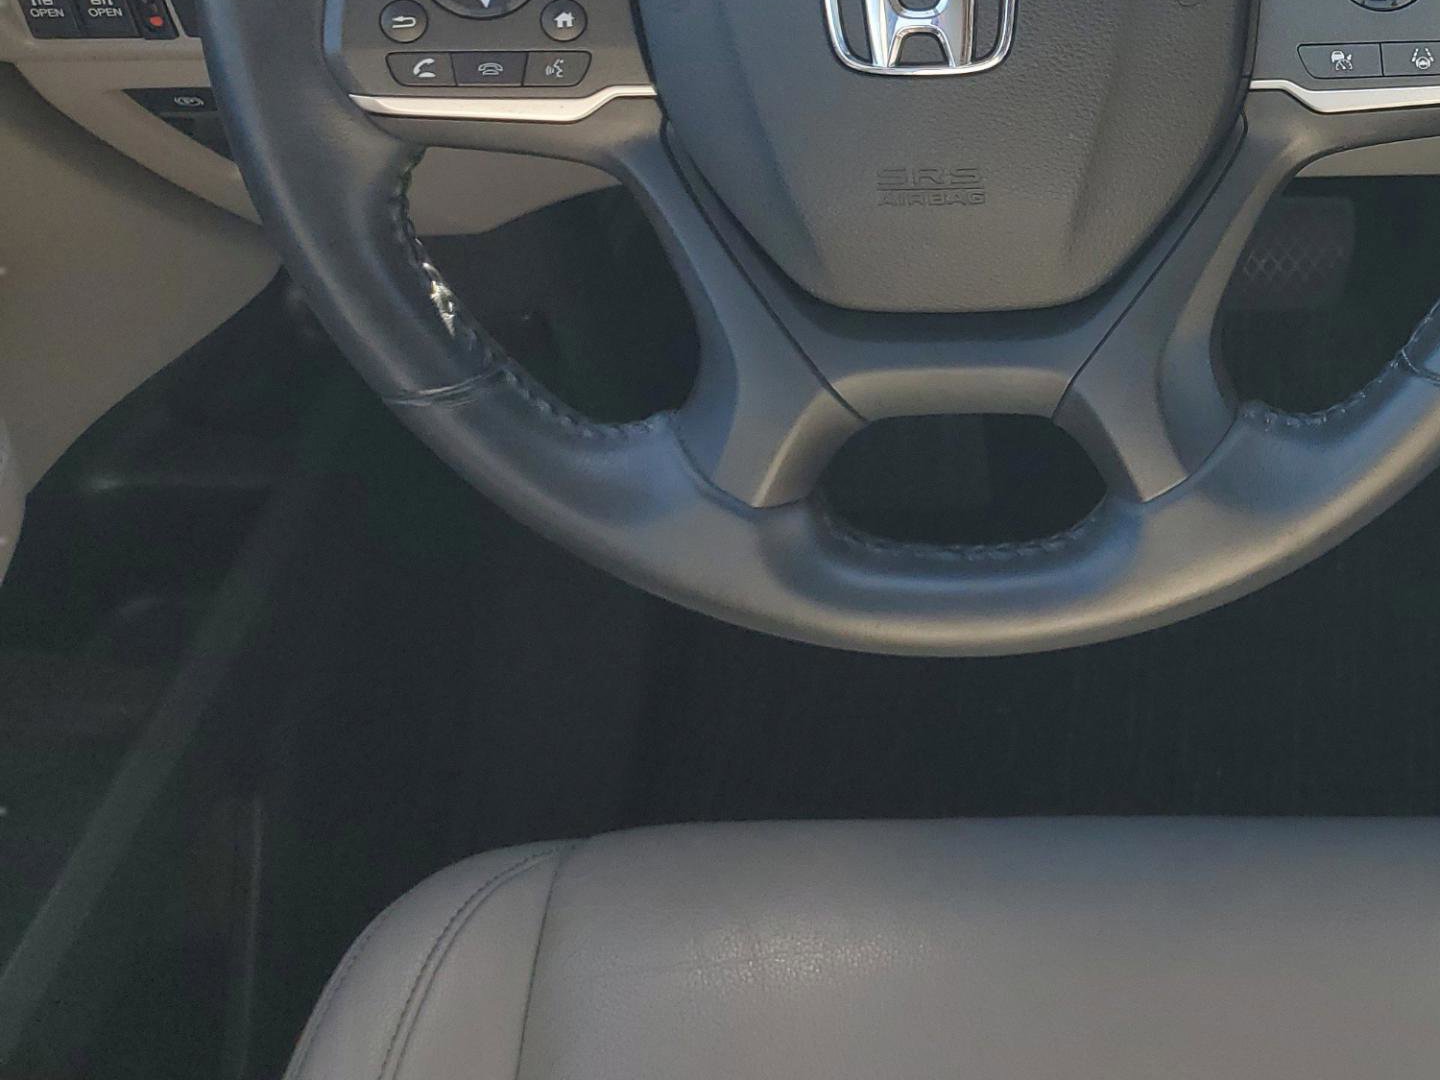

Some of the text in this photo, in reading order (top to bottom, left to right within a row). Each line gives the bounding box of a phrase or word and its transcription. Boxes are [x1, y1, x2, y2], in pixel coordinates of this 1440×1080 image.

[30, 8, 65, 18] OPEN
[88, 8, 123, 18] OPEN
[877, 168, 981, 186] SRS
[877, 192, 987, 207] AIRBAG
